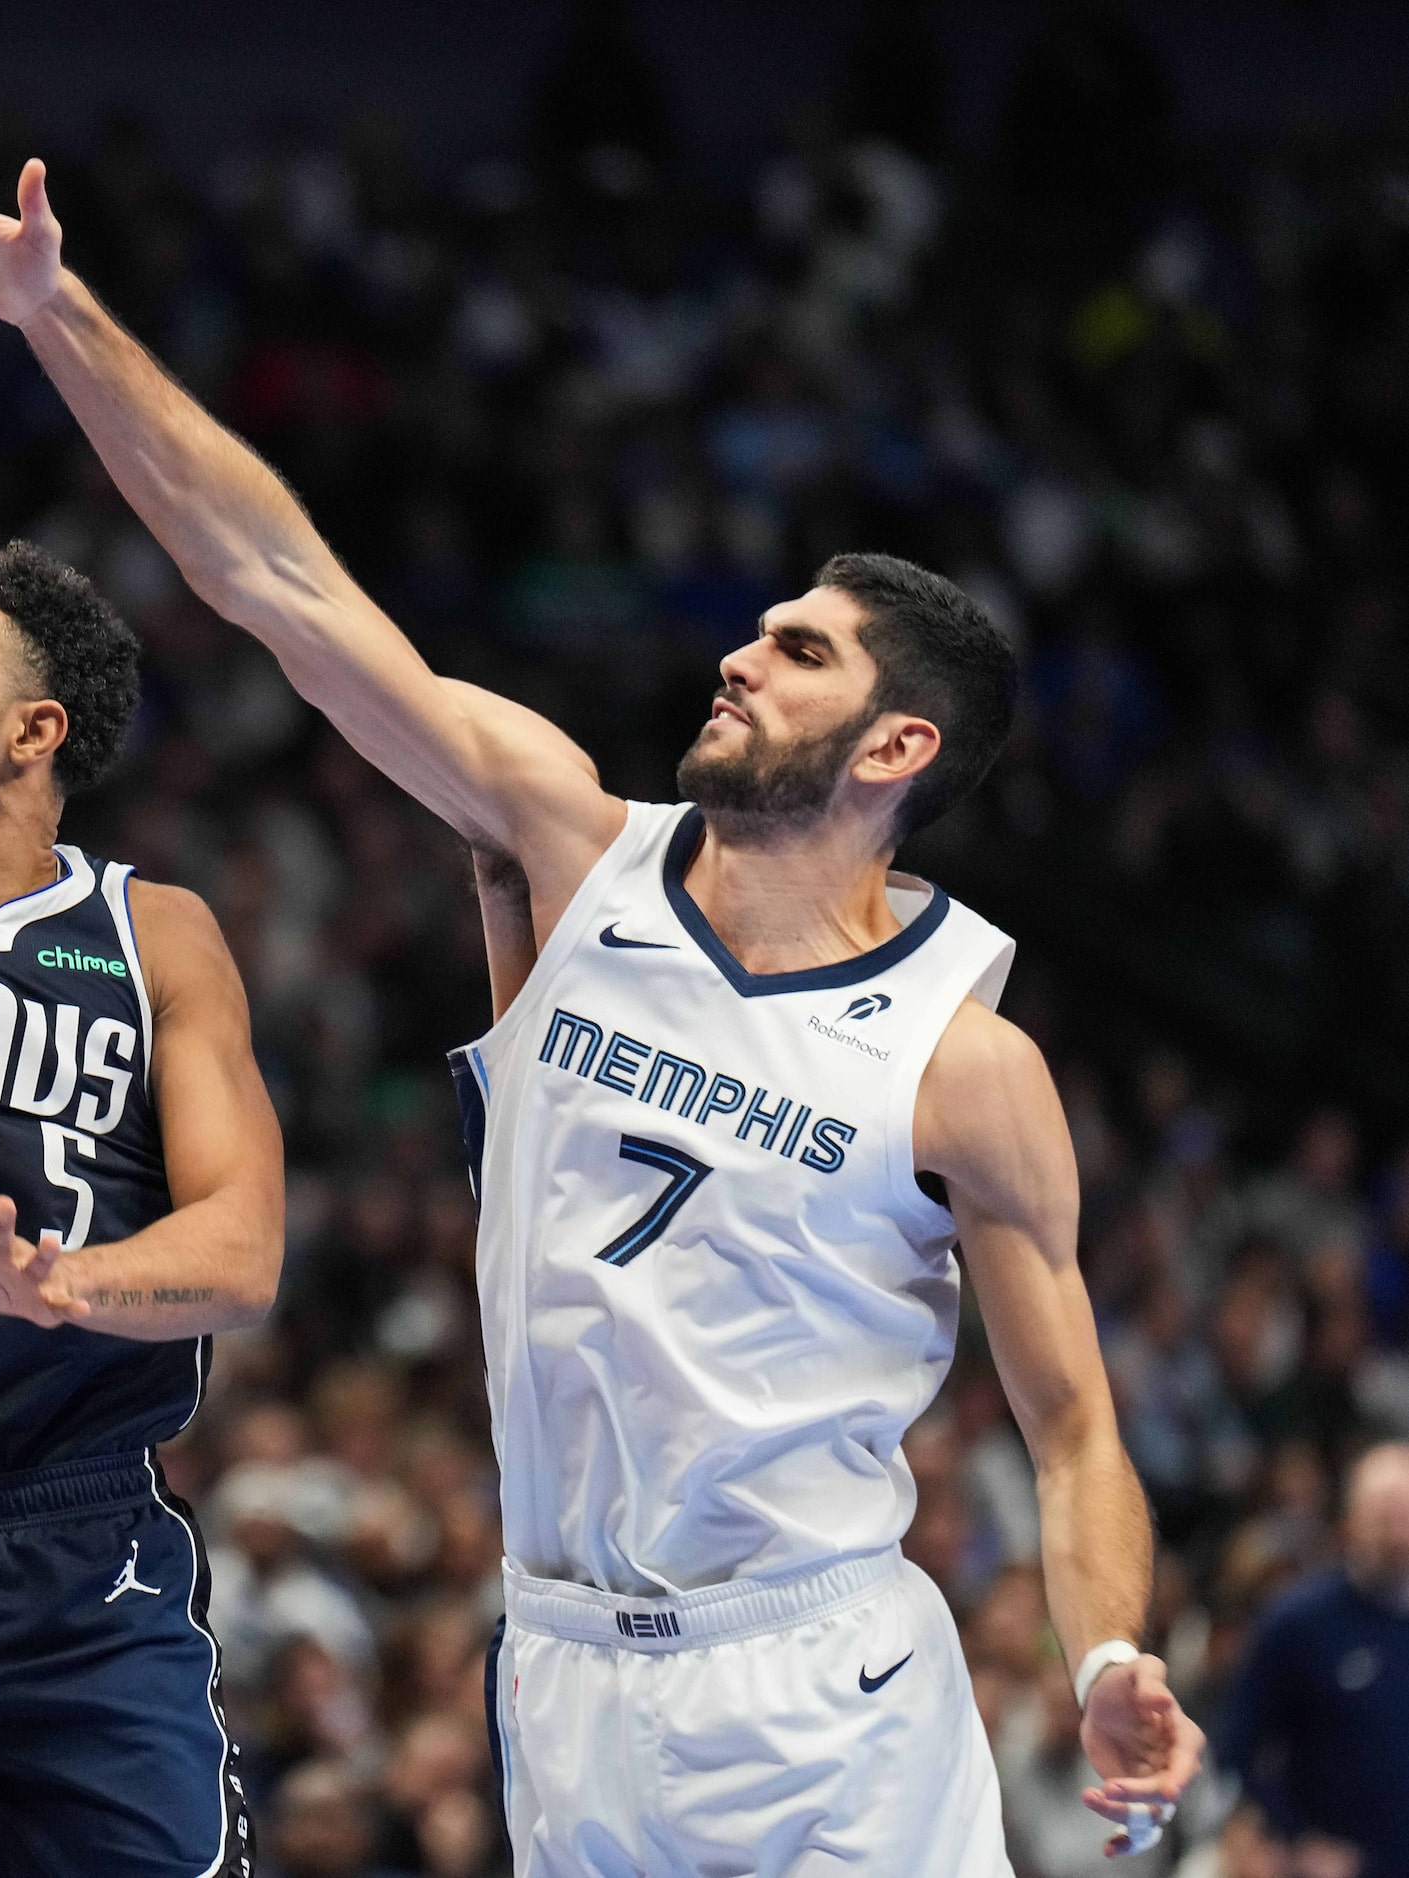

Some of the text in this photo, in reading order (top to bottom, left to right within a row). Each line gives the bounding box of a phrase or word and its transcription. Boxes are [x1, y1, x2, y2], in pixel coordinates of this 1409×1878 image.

[37, 946, 127, 977] chime
[538, 1008, 857, 1173] MEMPHIS
[807, 1015, 891, 1061] Robinhood
[40, 1121, 96, 1252] 5
[595, 1134, 714, 1267] 7
